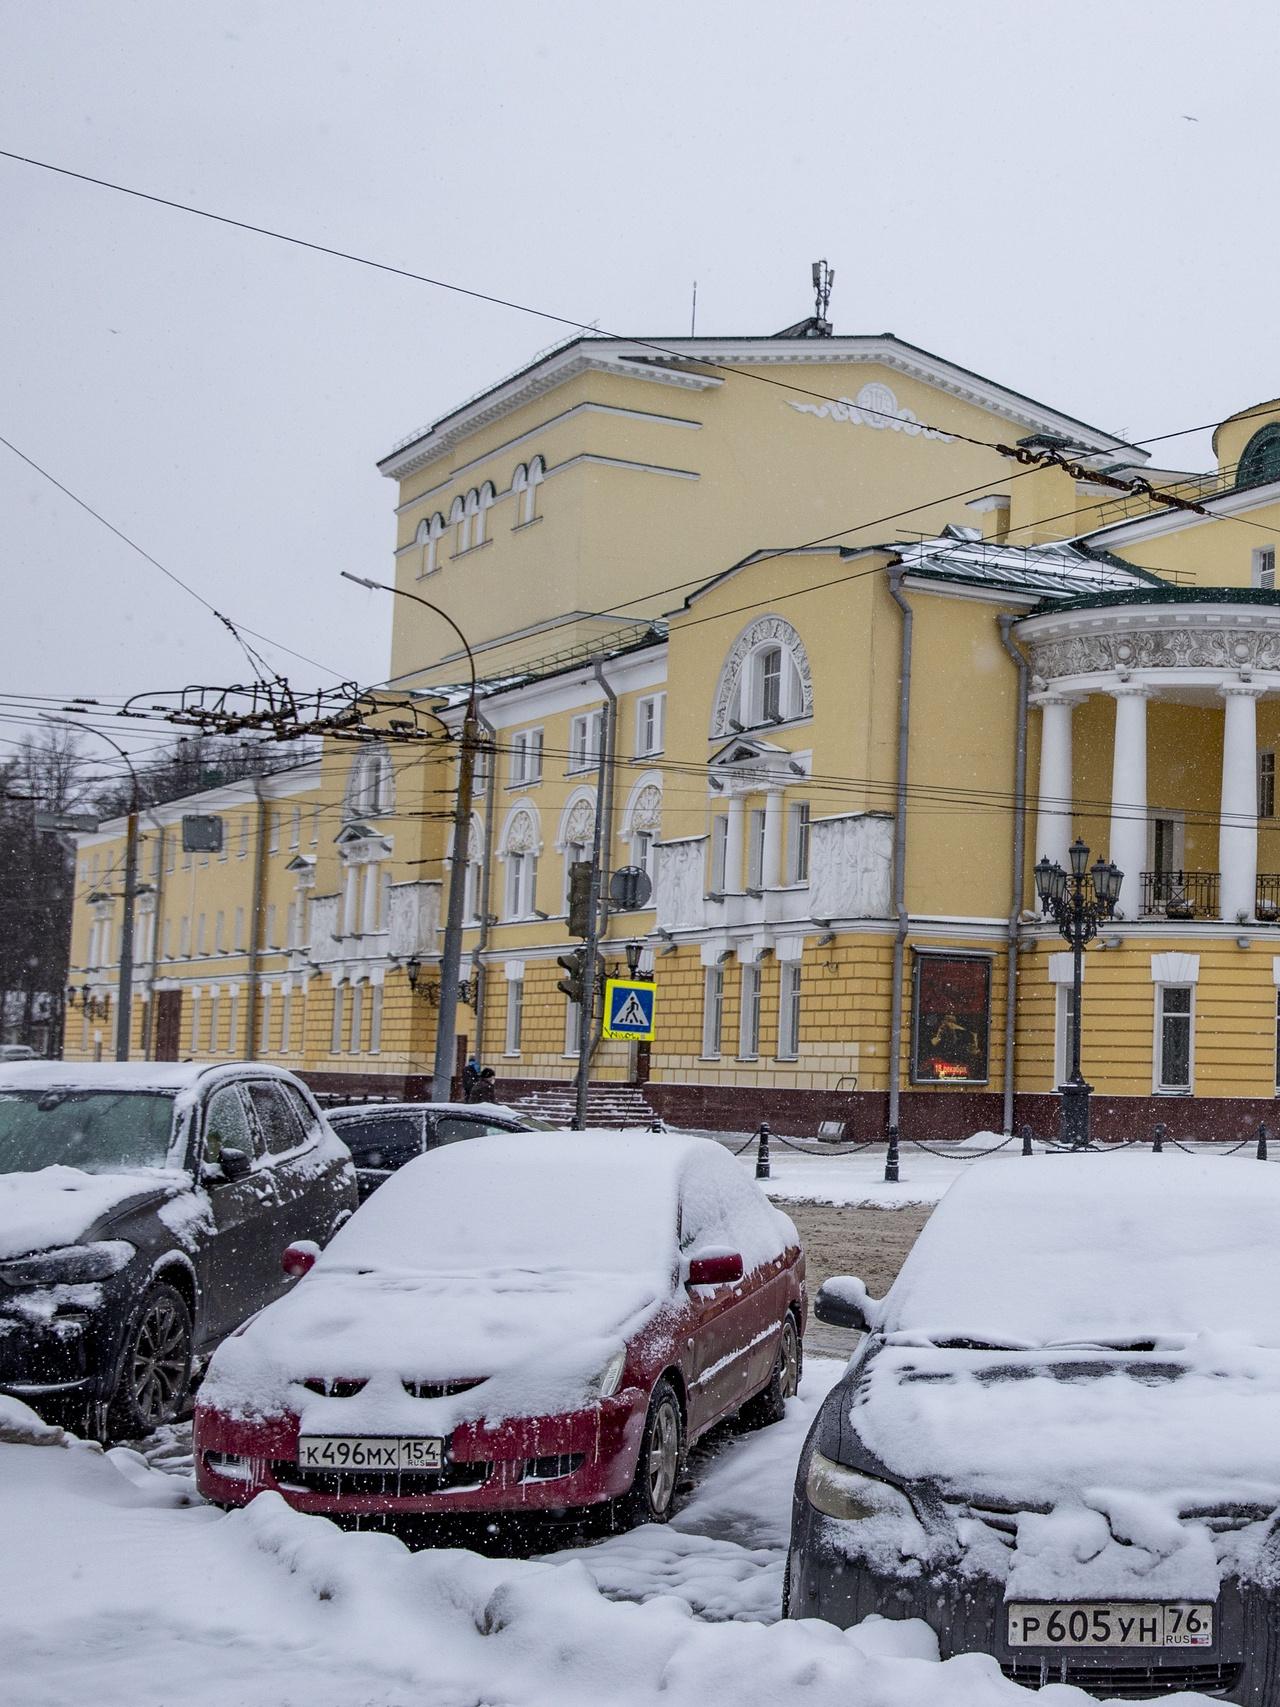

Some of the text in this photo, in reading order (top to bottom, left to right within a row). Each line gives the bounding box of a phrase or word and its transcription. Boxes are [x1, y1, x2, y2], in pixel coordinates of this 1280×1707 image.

[307, 1442, 436, 1466] К496МХ 154
[1022, 1608, 1202, 1643] Р605УН 76
[1166, 1635, 1190, 1644] RUS
